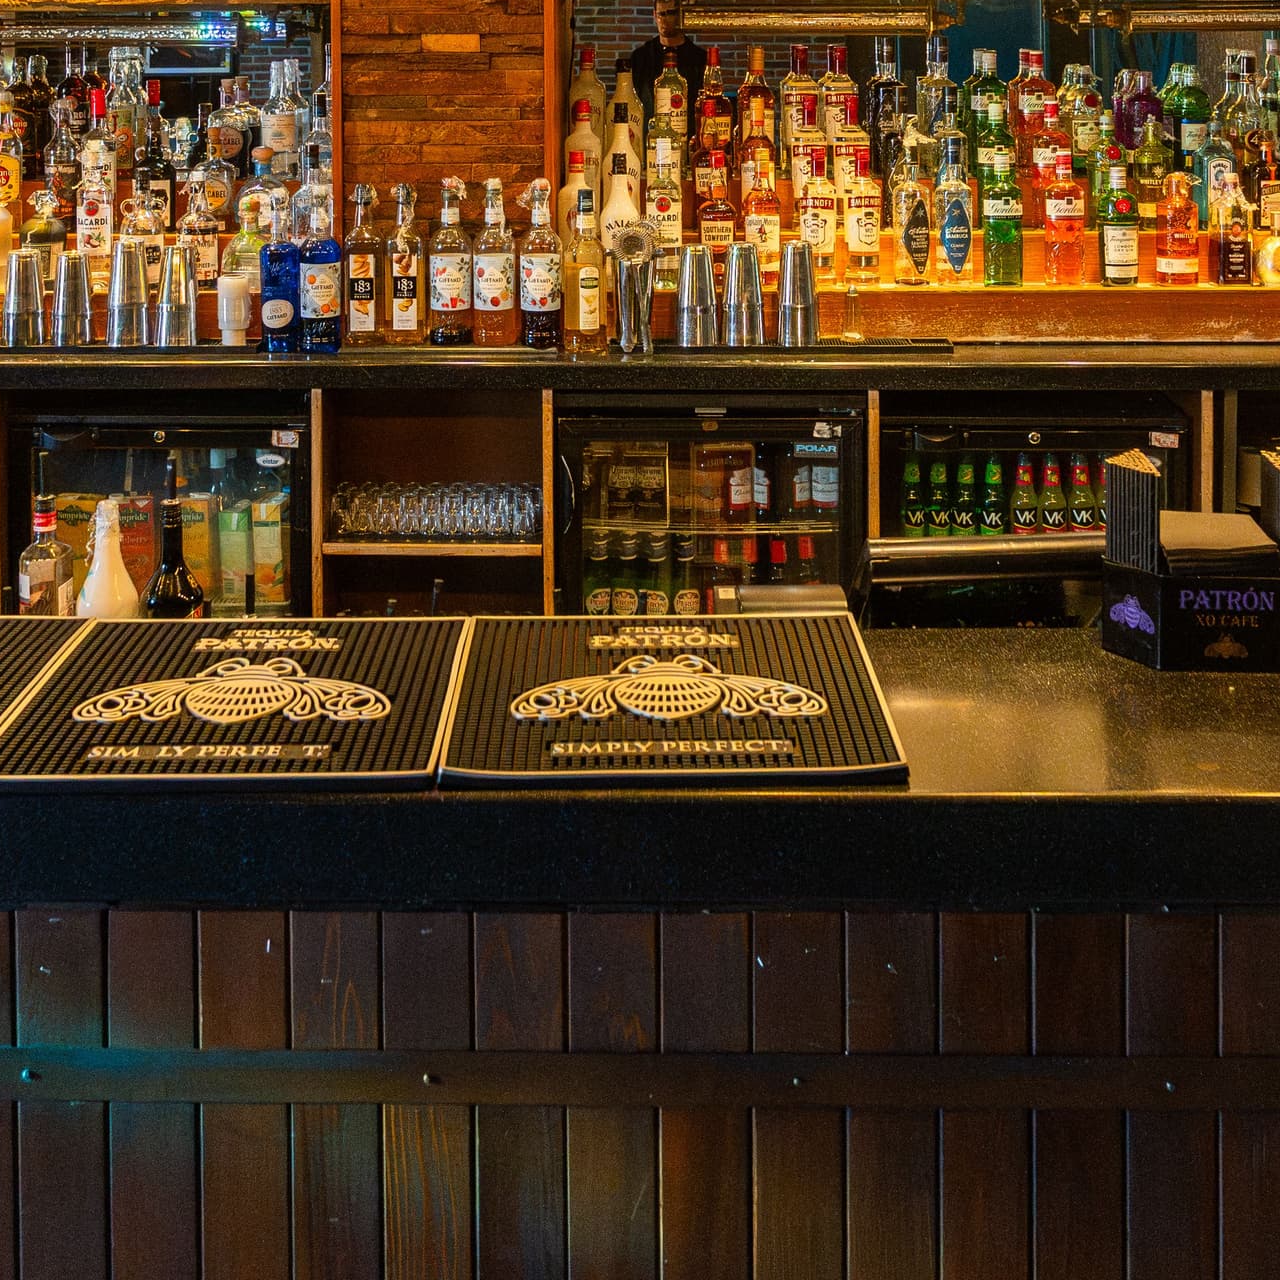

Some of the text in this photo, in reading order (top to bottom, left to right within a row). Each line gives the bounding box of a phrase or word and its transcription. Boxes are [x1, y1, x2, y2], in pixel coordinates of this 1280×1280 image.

[785, 95, 804, 103] SMIR
[794, 146, 812, 155] SMIR
[836, 146, 854, 155] SMIR
[703, 225, 732, 234] SOUTHERN
[704, 234, 731, 242] COMFORT
[795, 444, 838, 453] POLAR
[907, 510, 924, 524] VK
[931, 510, 949, 524] VK
[953, 510, 973, 525] VK
[982, 511, 1002, 525] VK
[1015, 509, 1035, 523] VK
[1044, 510, 1064, 524] VK
[1072, 509, 1093, 523] VK
[1179, 586, 1276, 612] PATRÓN
[1195, 614, 1216, 627] XO
[233, 629, 315, 637] TEQUILA
[87, 745, 193, 758] SIMLY
[551, 742, 658, 754] SIMPLY
